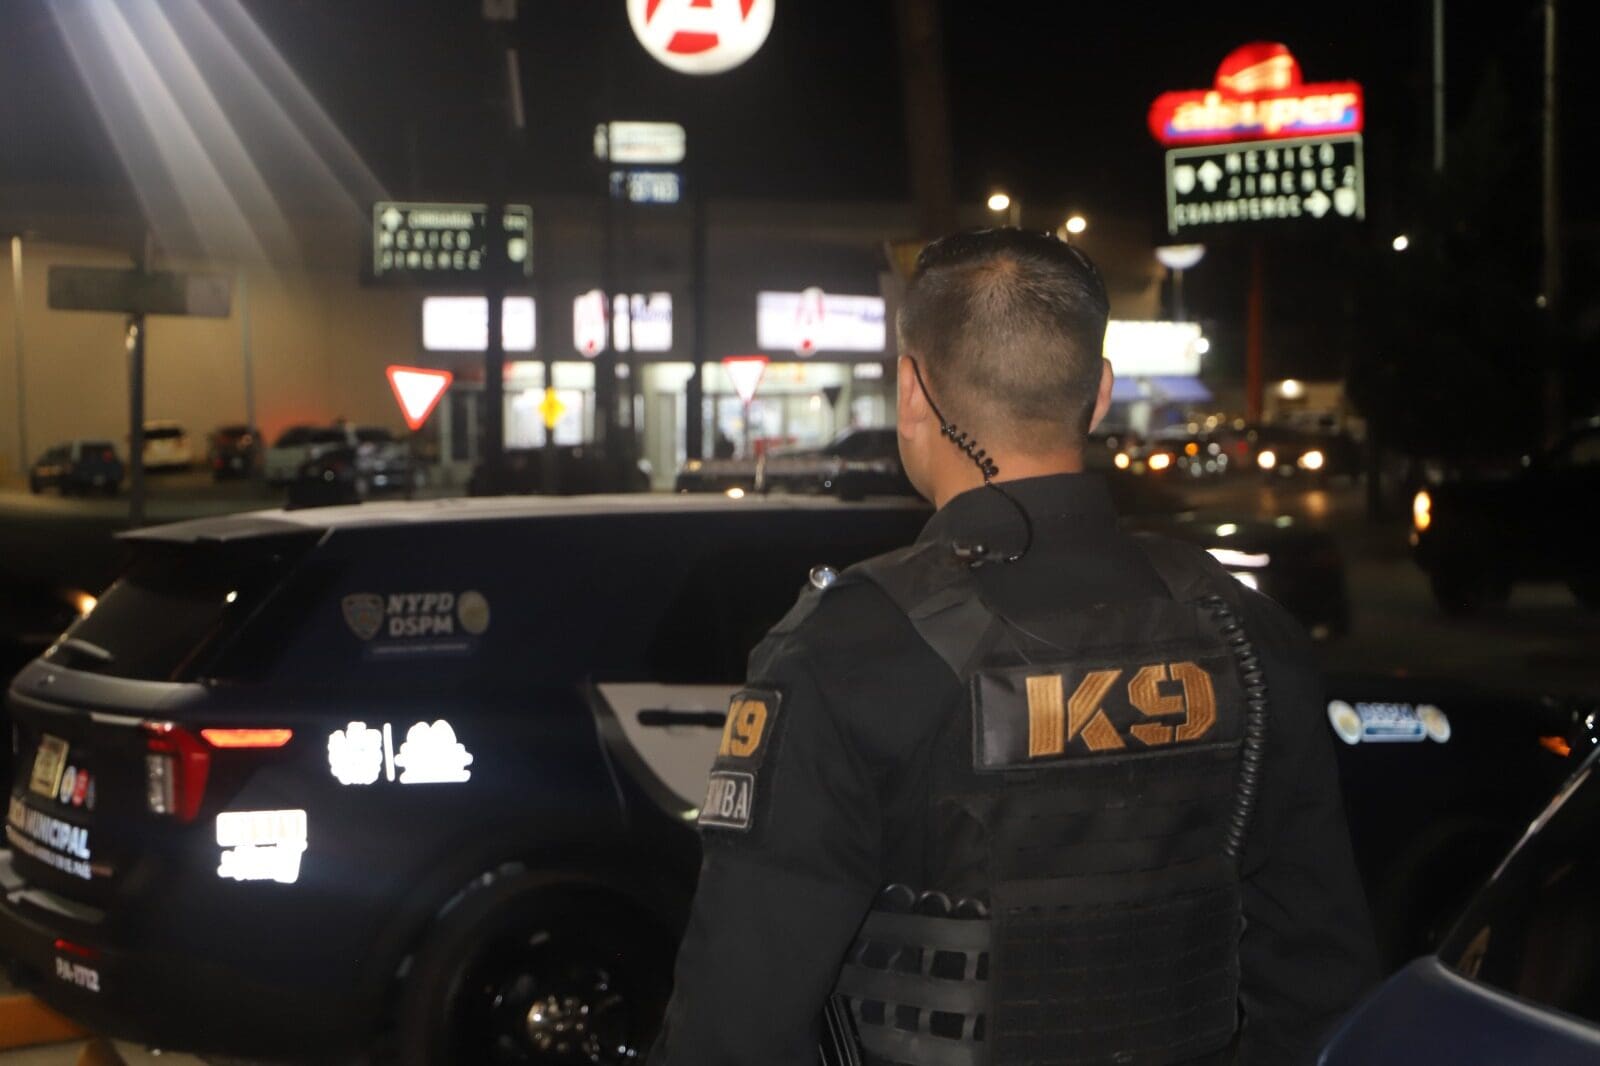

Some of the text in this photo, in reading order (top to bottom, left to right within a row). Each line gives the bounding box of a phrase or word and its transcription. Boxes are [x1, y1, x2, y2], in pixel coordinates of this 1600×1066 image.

[386, 592, 455, 615] NYPD
[389, 614, 454, 636] DSPM
[1025, 661, 1217, 758] K9
